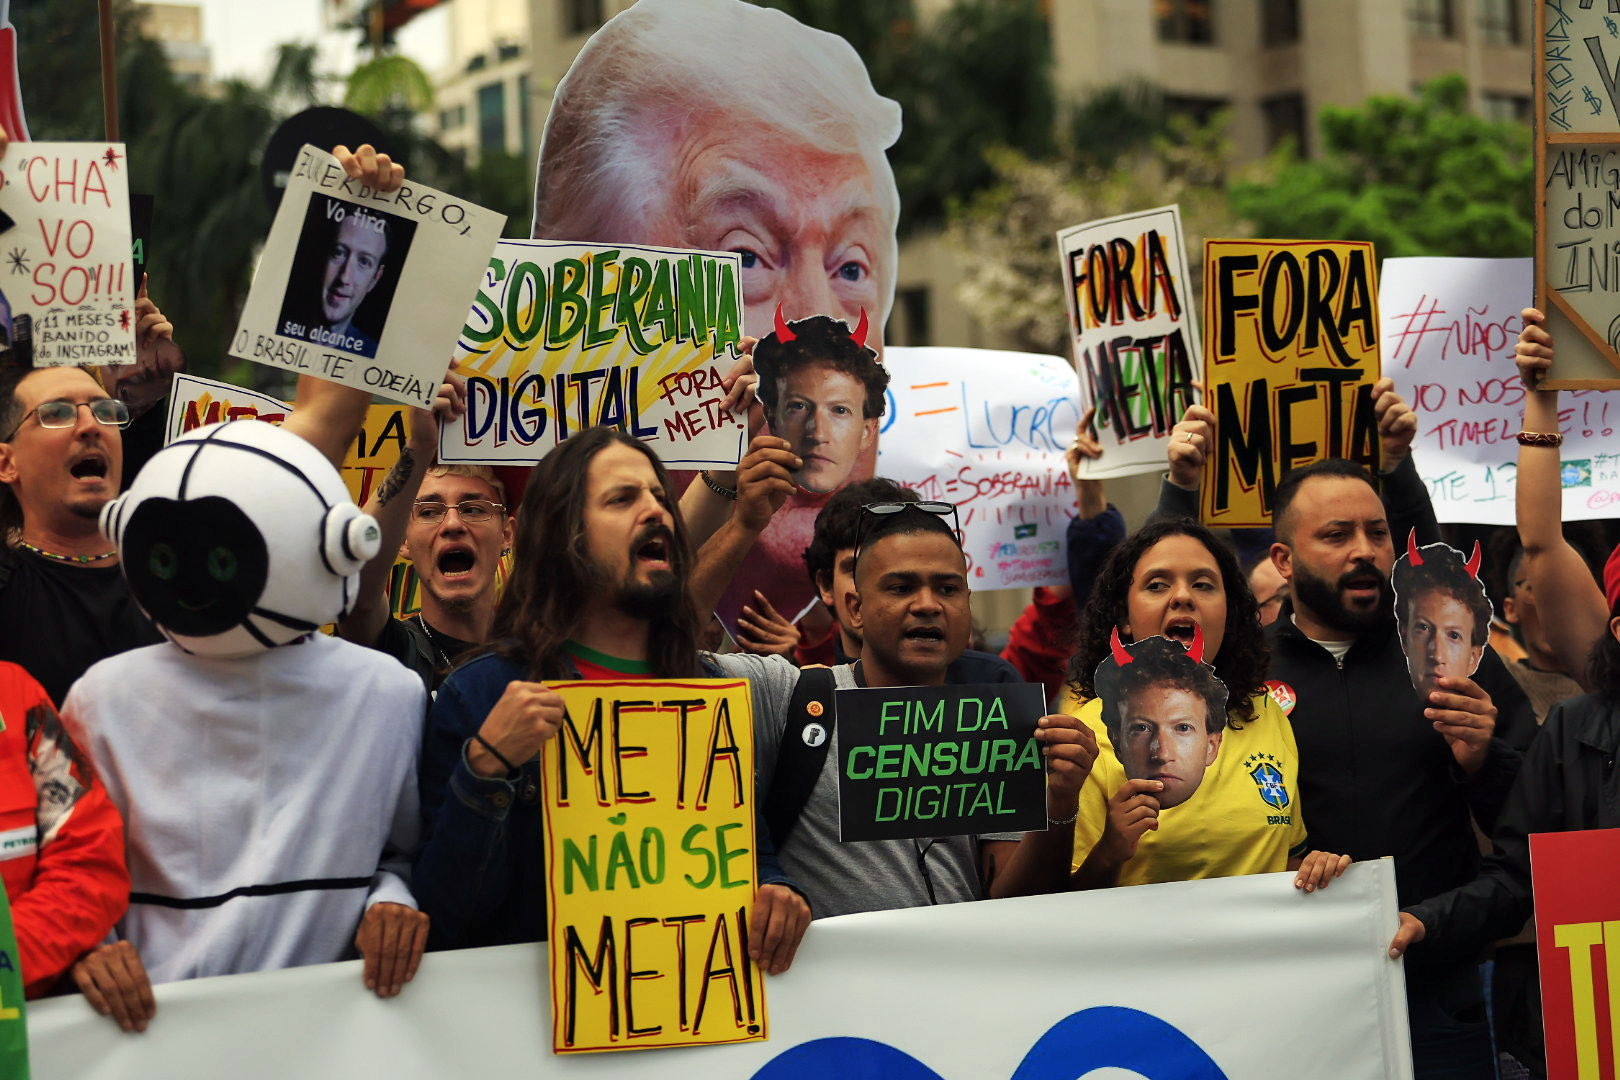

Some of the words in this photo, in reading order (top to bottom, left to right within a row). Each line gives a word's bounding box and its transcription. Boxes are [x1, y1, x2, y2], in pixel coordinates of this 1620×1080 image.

[38, 219, 94, 259] VO
[327, 199, 346, 222] Vo
[352, 207, 386, 234] tira
[462, 250, 743, 354] SOBERANIA
[1067, 230, 1181, 335] FORA
[1219, 249, 1376, 367] FORA
[57, 342, 136, 359] INSTAGRAM!
[66, 313, 115, 327] MESES
[235, 330, 249, 354] O
[253, 335, 309, 368] BRASIL
[322, 353, 353, 380] TE
[283, 320, 306, 338] seu
[309, 329, 364, 351] alcance
[1388, 294, 1524, 369] #NÃOS
[466, 366, 659, 443] DIGITAL
[657, 366, 730, 406] FORA
[962, 381, 1079, 454] LUCRO
[1083, 328, 1196, 444] META
[1216, 368, 1380, 511] META
[557, 697, 745, 808] META
[879, 700, 945, 736] FIM
[956, 697, 1008, 732] DA
[846, 738, 1041, 780] CENSURA
[875, 781, 1016, 822] DIGITAL
[563, 812, 665, 894] NÃO
[681, 823, 749, 889] SE
[564, 905, 760, 1046] META!
